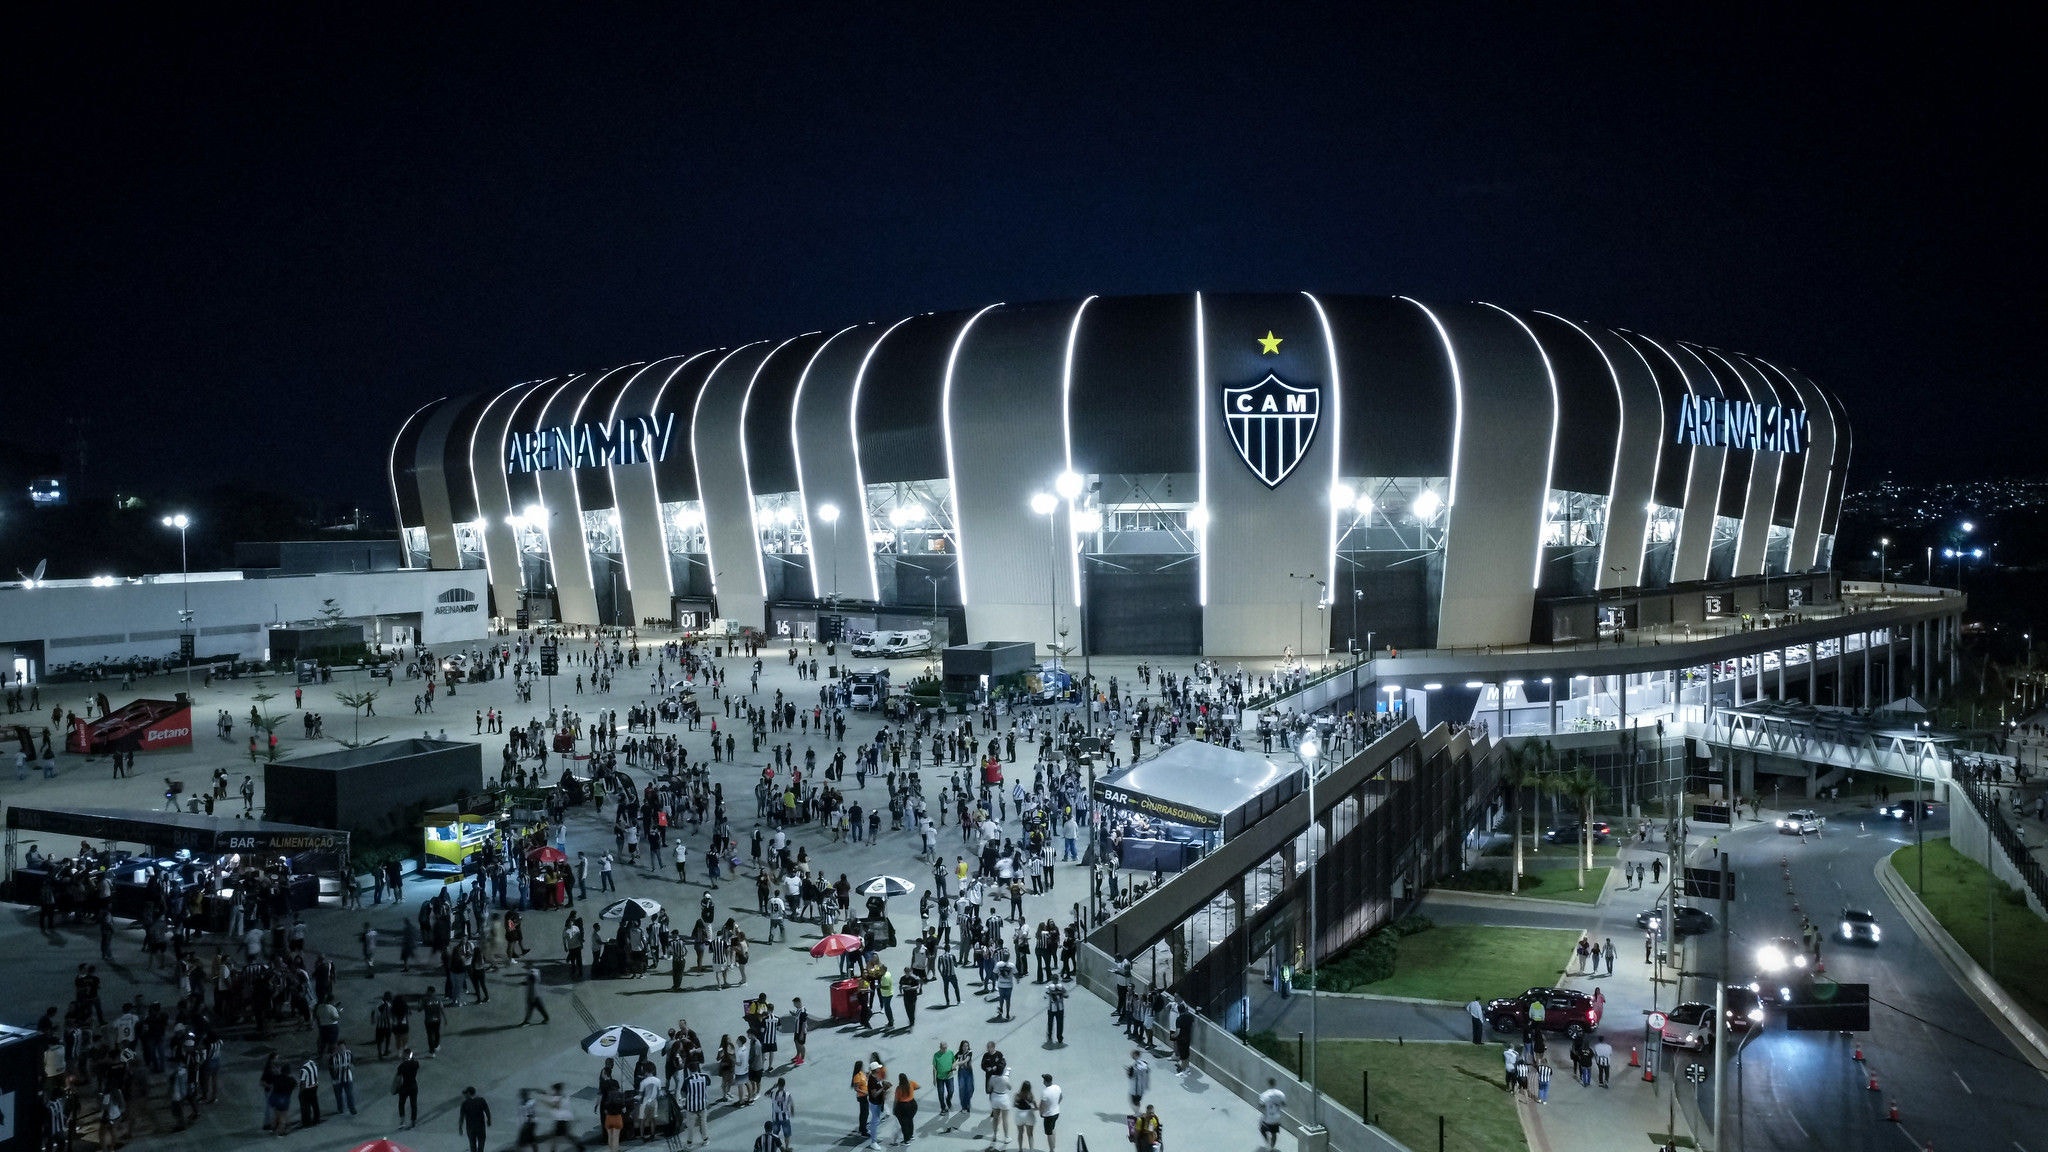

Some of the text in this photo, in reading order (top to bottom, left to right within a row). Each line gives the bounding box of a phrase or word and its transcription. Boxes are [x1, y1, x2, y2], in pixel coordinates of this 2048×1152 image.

[1705, 599, 1721, 614] 13
[681, 613, 697, 628] 01
[775, 620, 791, 635] 16
[147, 727, 190, 742] Betano
[1104, 789, 1208, 824] BAR CHURRASQUINHO
[229, 834, 334, 849] BAR ALIMENTAÇÃO
